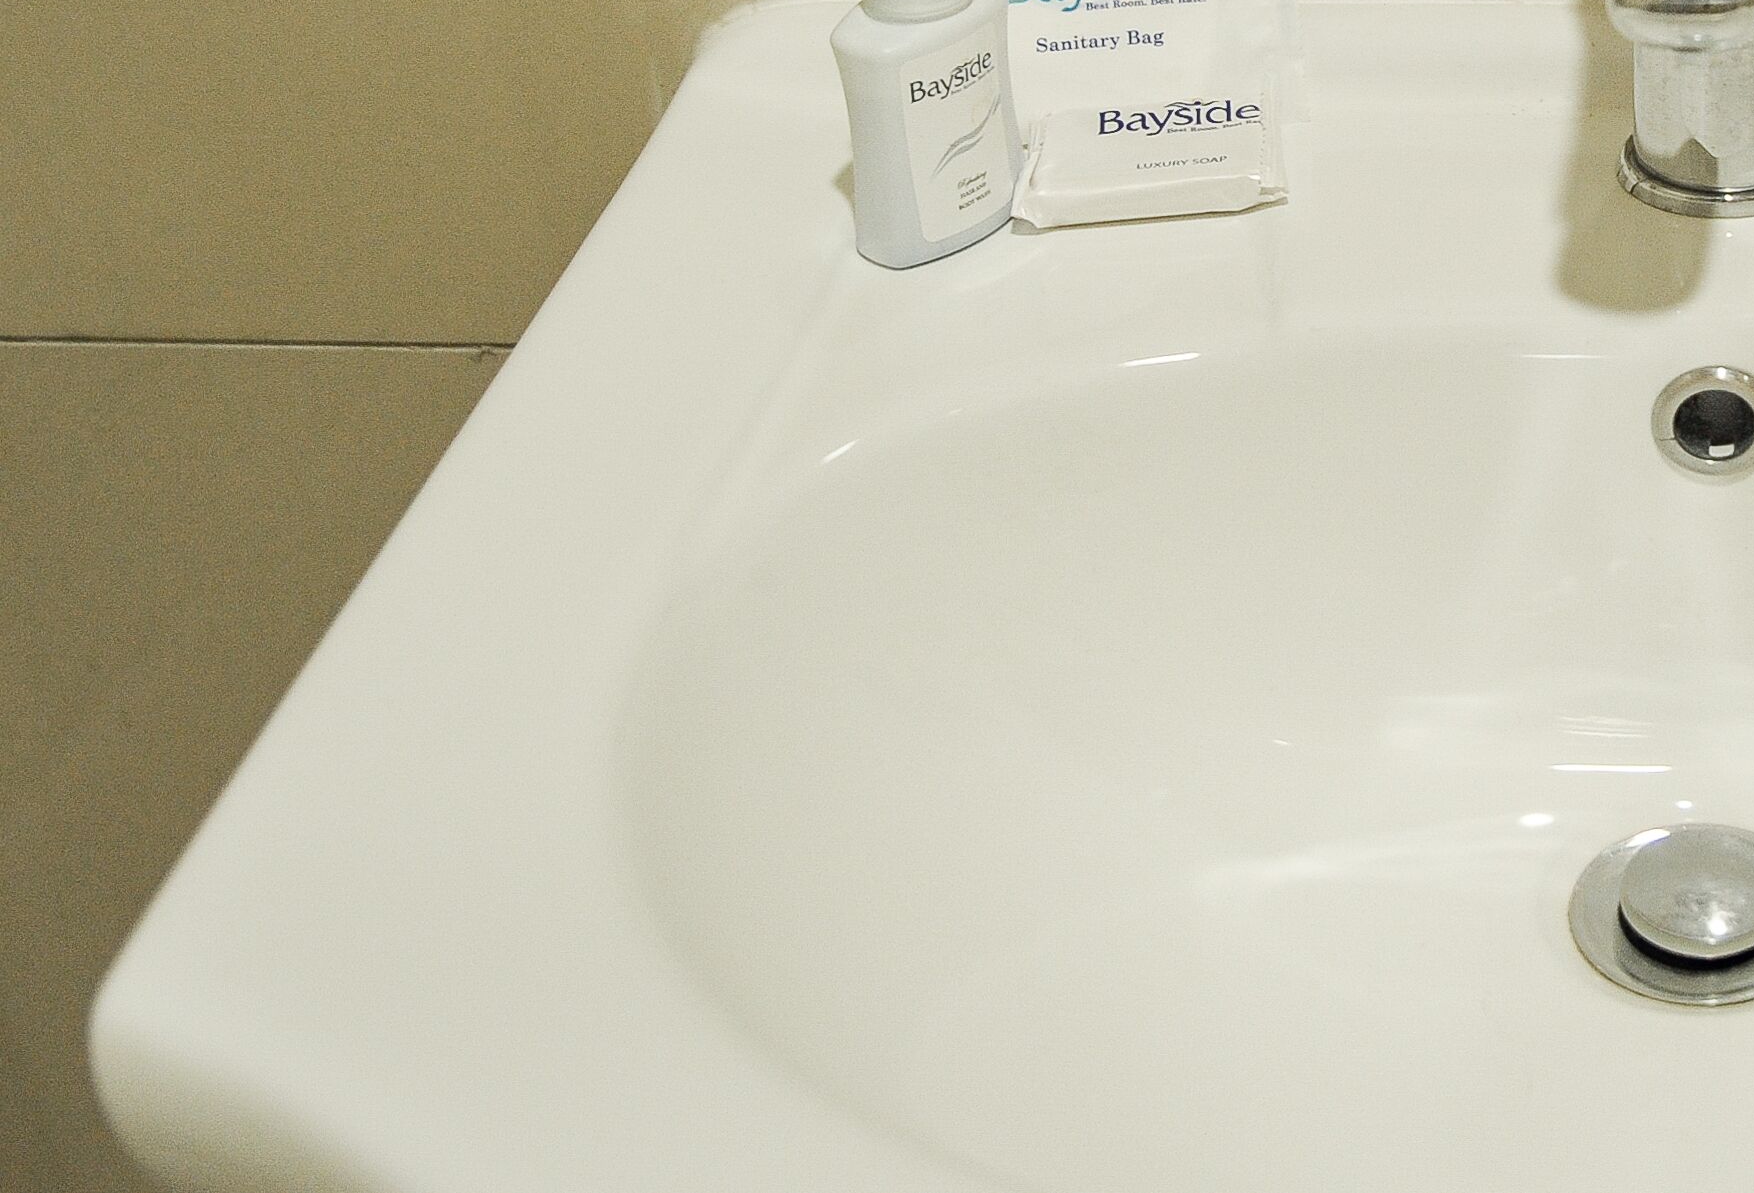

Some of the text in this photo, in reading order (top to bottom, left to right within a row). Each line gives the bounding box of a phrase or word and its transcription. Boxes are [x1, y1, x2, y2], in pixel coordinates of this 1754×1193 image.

[1036, 29, 1165, 54] Sanitary Bag
[909, 52, 992, 104] Bayside
[1098, 99, 1262, 137] Bayside
[1136, 155, 1227, 171] LUXURY SOAP
